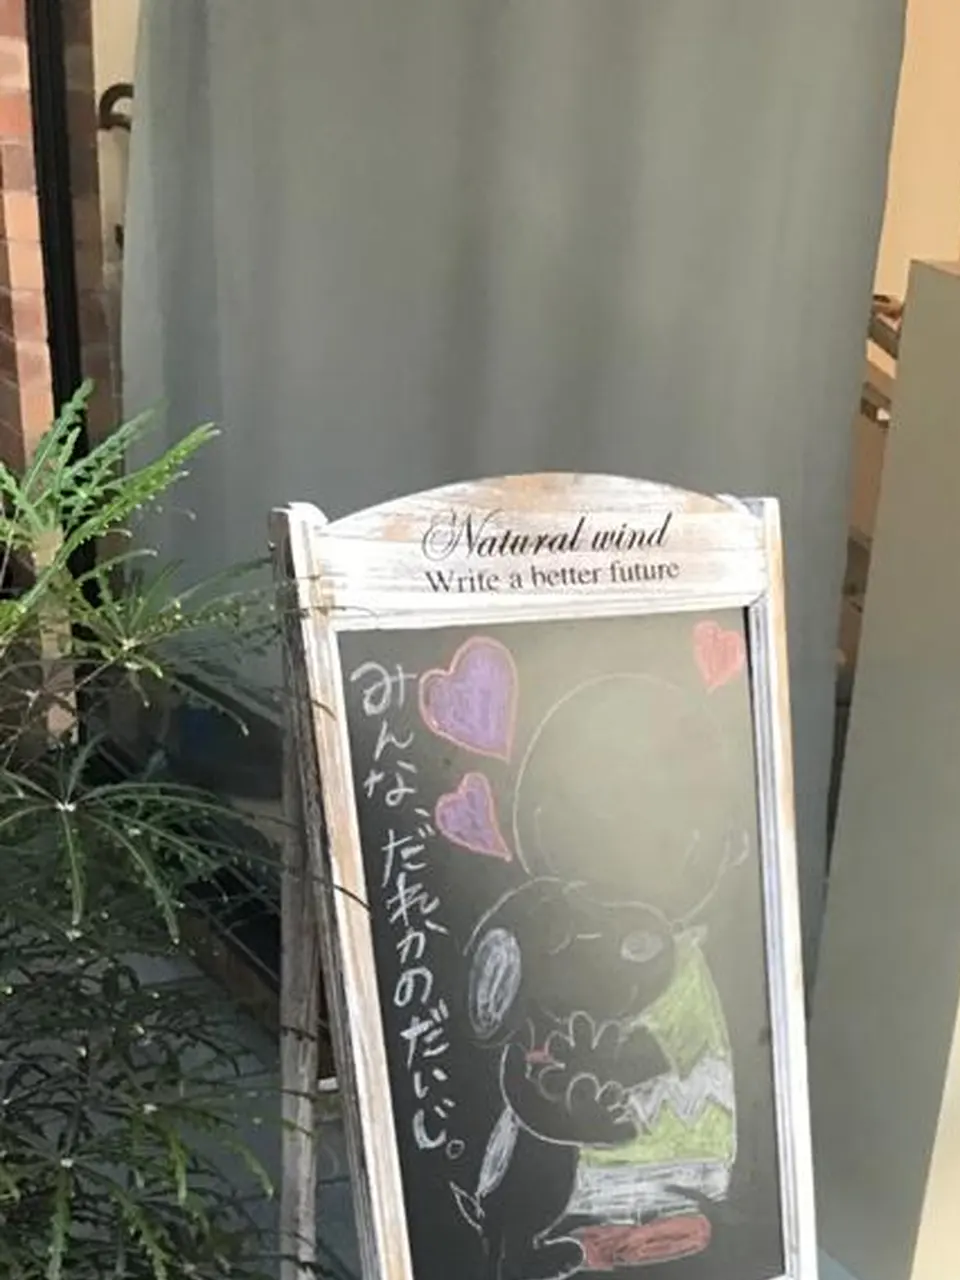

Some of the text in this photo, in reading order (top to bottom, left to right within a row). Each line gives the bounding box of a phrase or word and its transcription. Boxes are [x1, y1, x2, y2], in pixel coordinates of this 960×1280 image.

[421, 508, 672, 561] Natural wind
[425, 559, 681, 593] Write a better future
